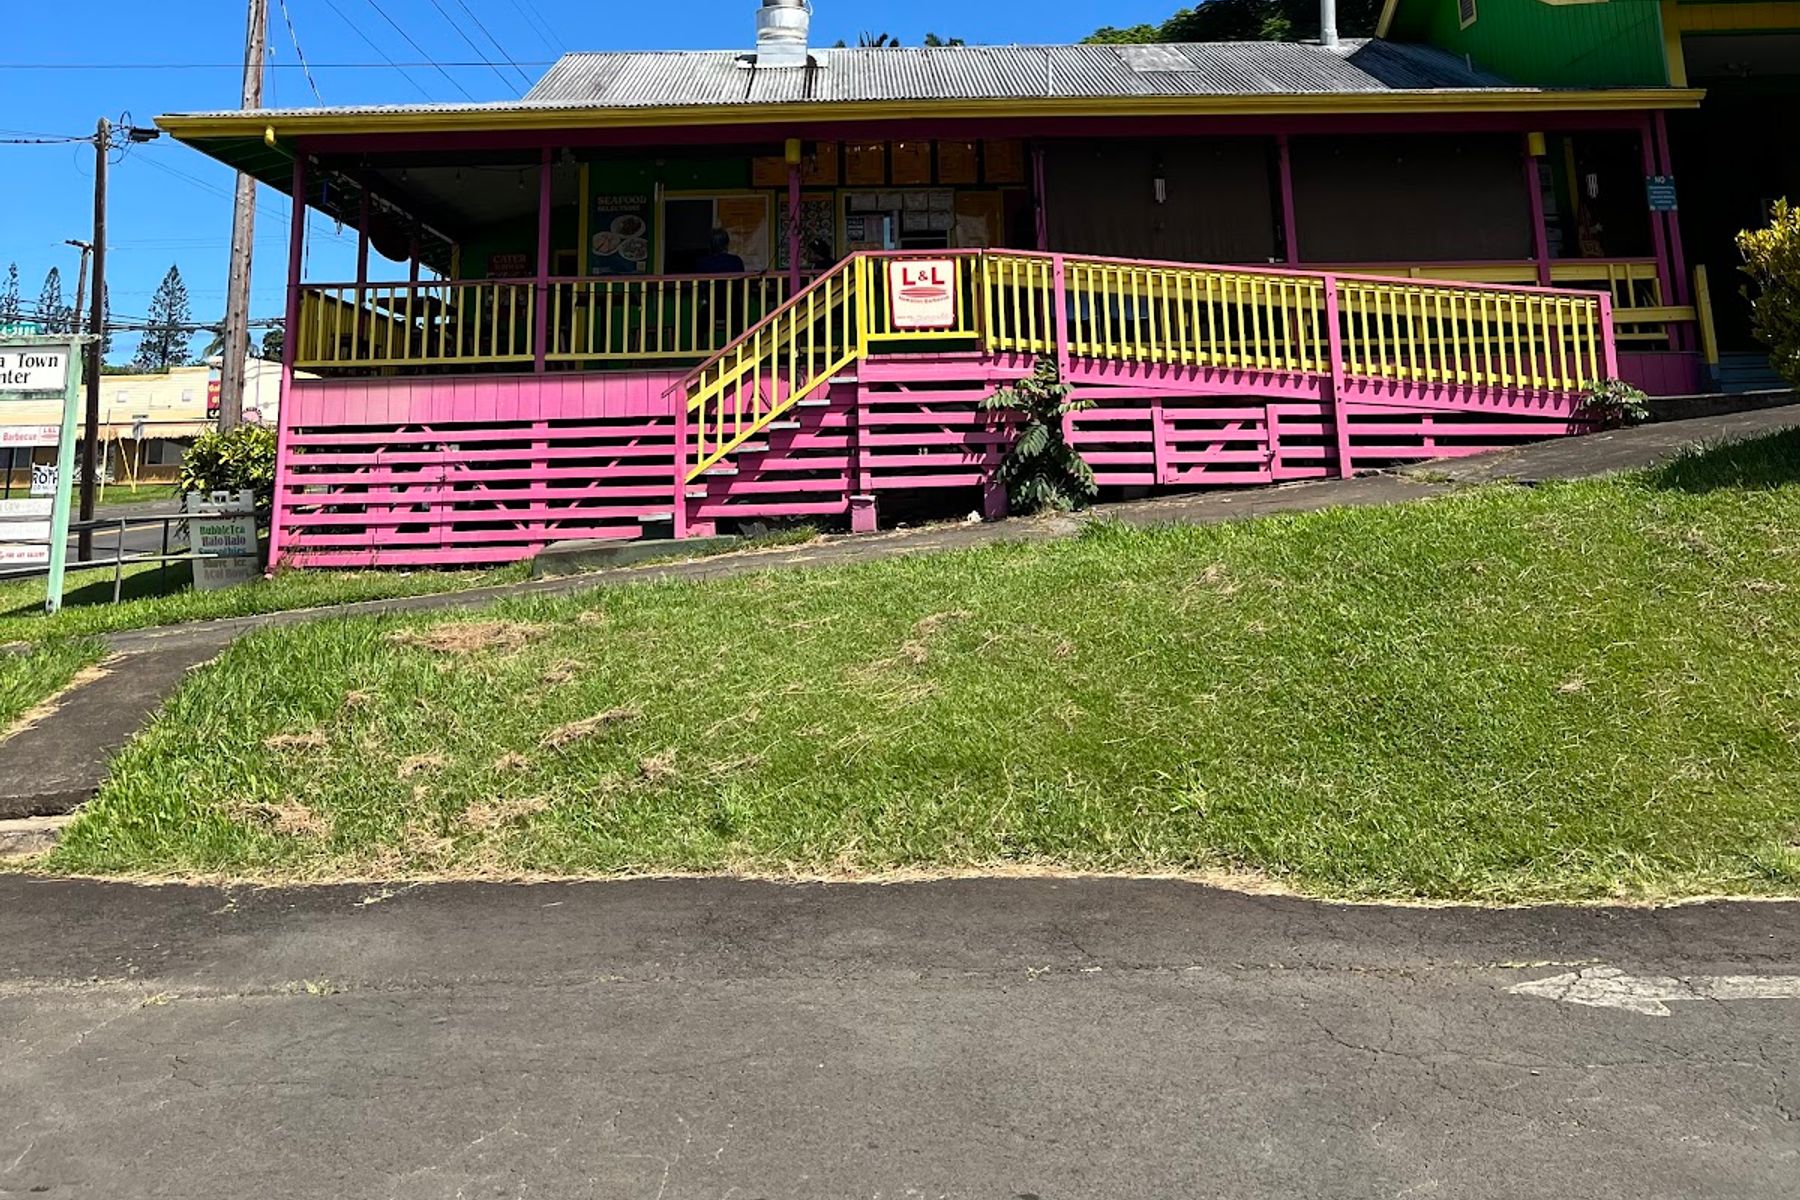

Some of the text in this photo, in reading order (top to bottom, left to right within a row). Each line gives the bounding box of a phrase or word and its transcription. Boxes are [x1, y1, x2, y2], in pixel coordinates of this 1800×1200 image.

[1654, 175, 1666, 184] NO
[597, 195, 647, 205] SEAFOOD
[17, 352, 59, 368] Town
[3, 432, 37, 441] Barbecue
